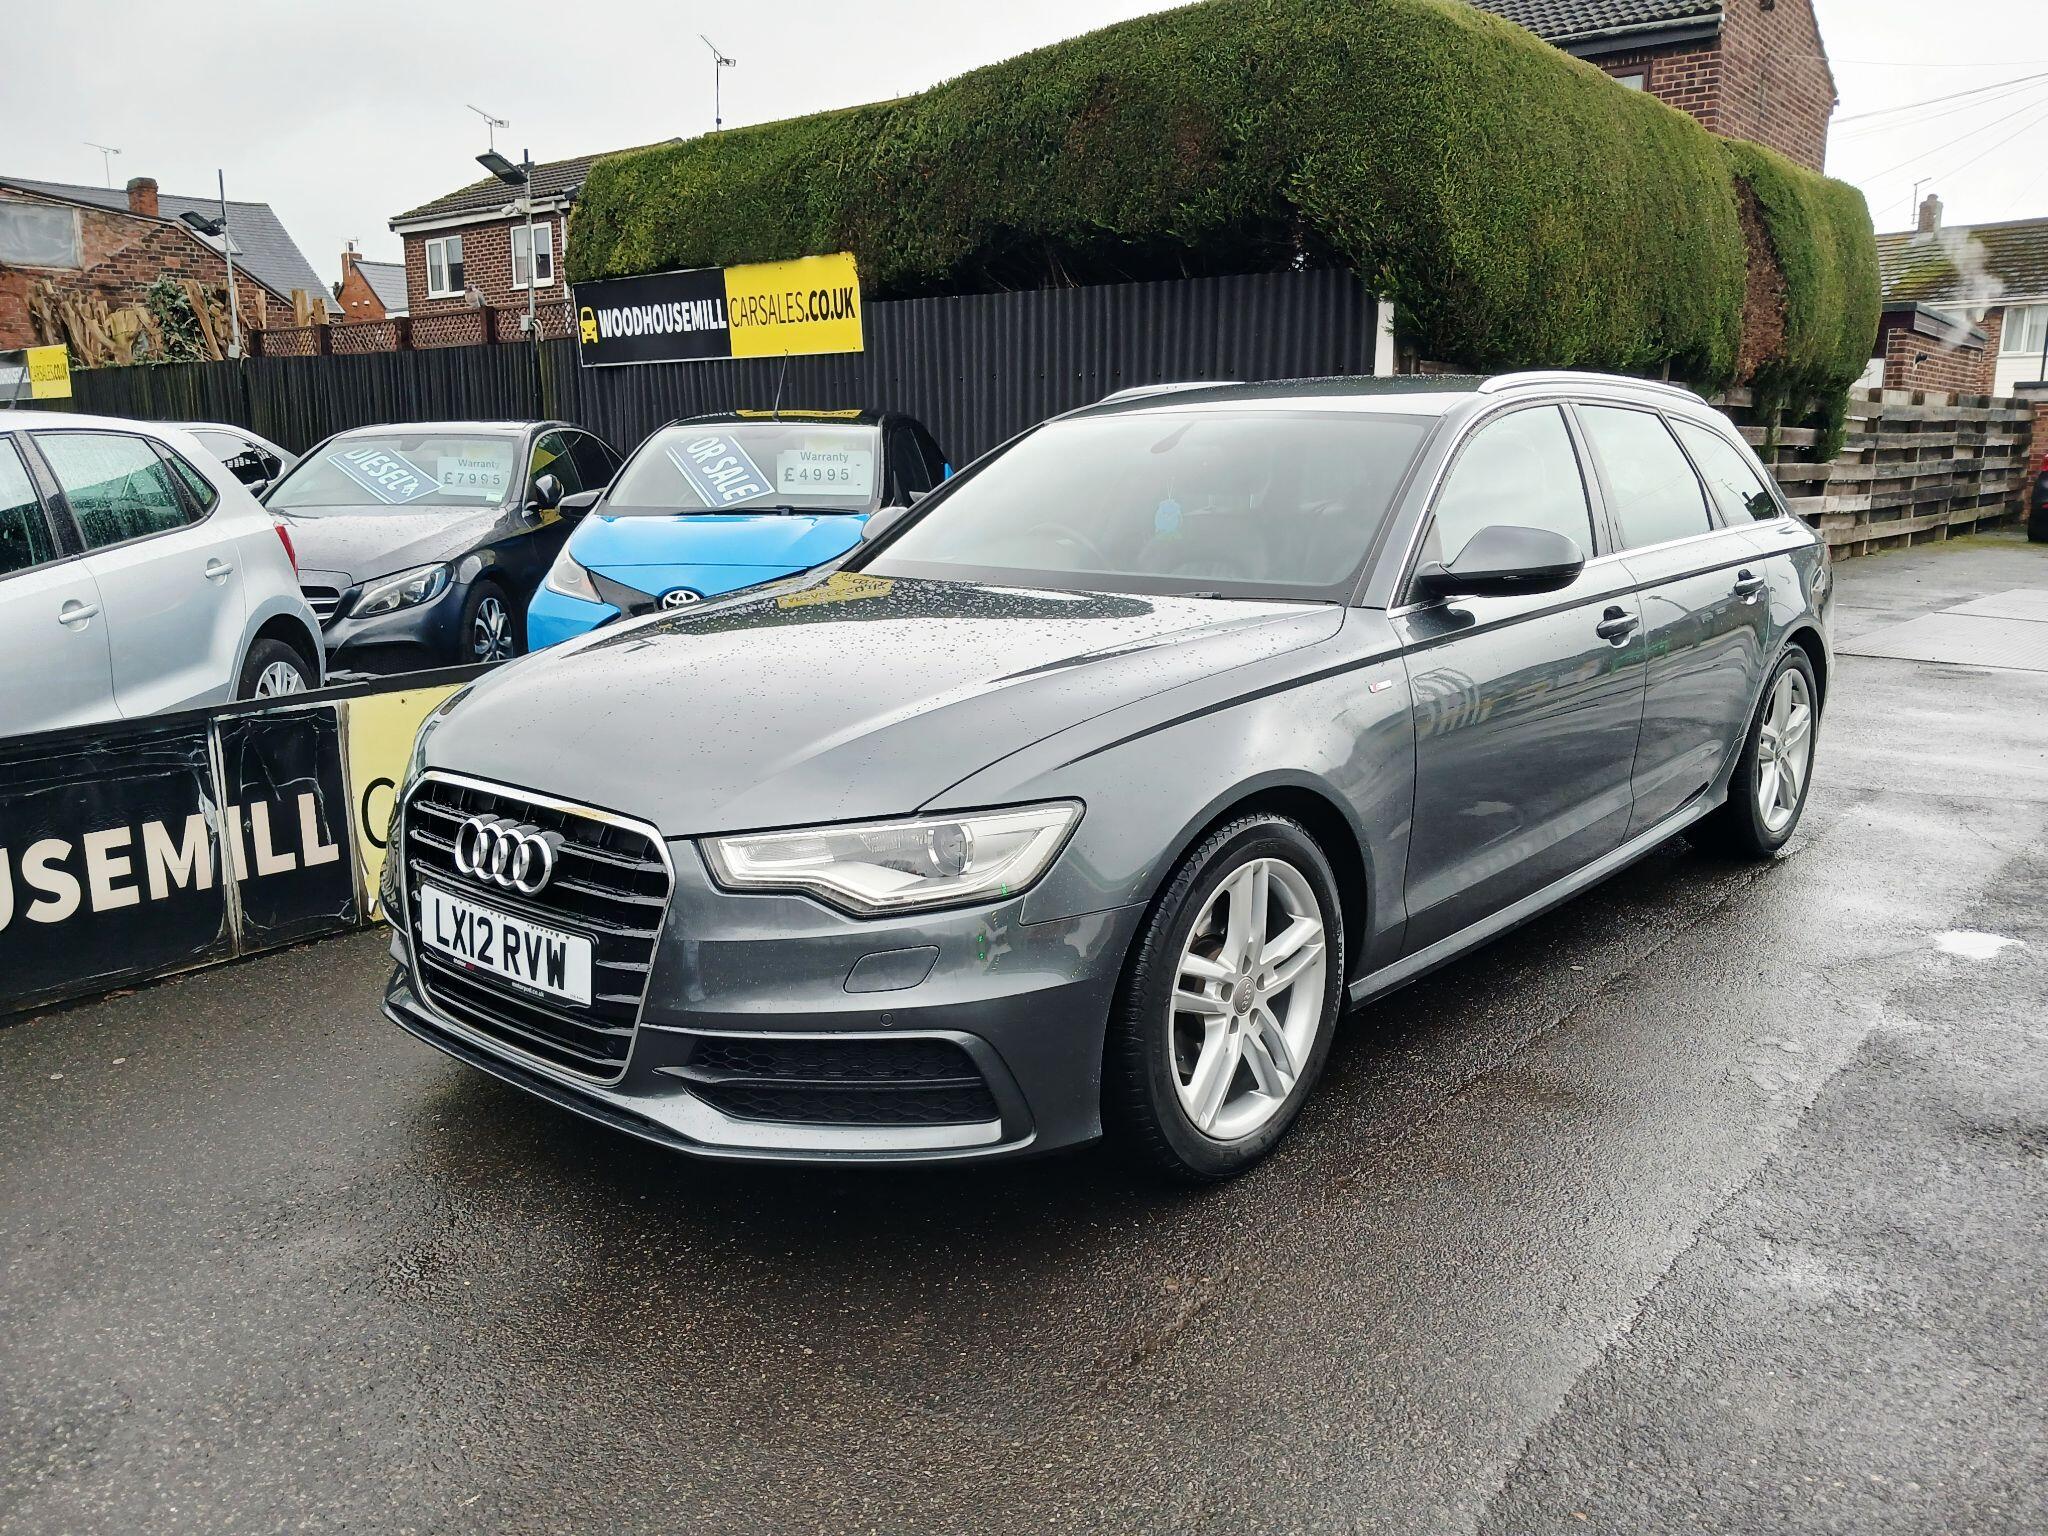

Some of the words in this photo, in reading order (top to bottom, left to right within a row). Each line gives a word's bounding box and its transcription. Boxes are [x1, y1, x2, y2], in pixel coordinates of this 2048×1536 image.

[597, 298, 727, 339] WOODHOUSEMILL
[730, 286, 857, 328] CARSALES.CO.UK
[680, 436, 727, 464] OR
[800, 451, 849, 463] Warranty
[343, 448, 415, 491] DIESEL
[444, 472, 501, 485] £7995
[702, 456, 760, 501] SALE
[784, 467, 849, 482] £4995
[435, 897, 494, 965] LX12
[503, 923, 567, 991] RVW
